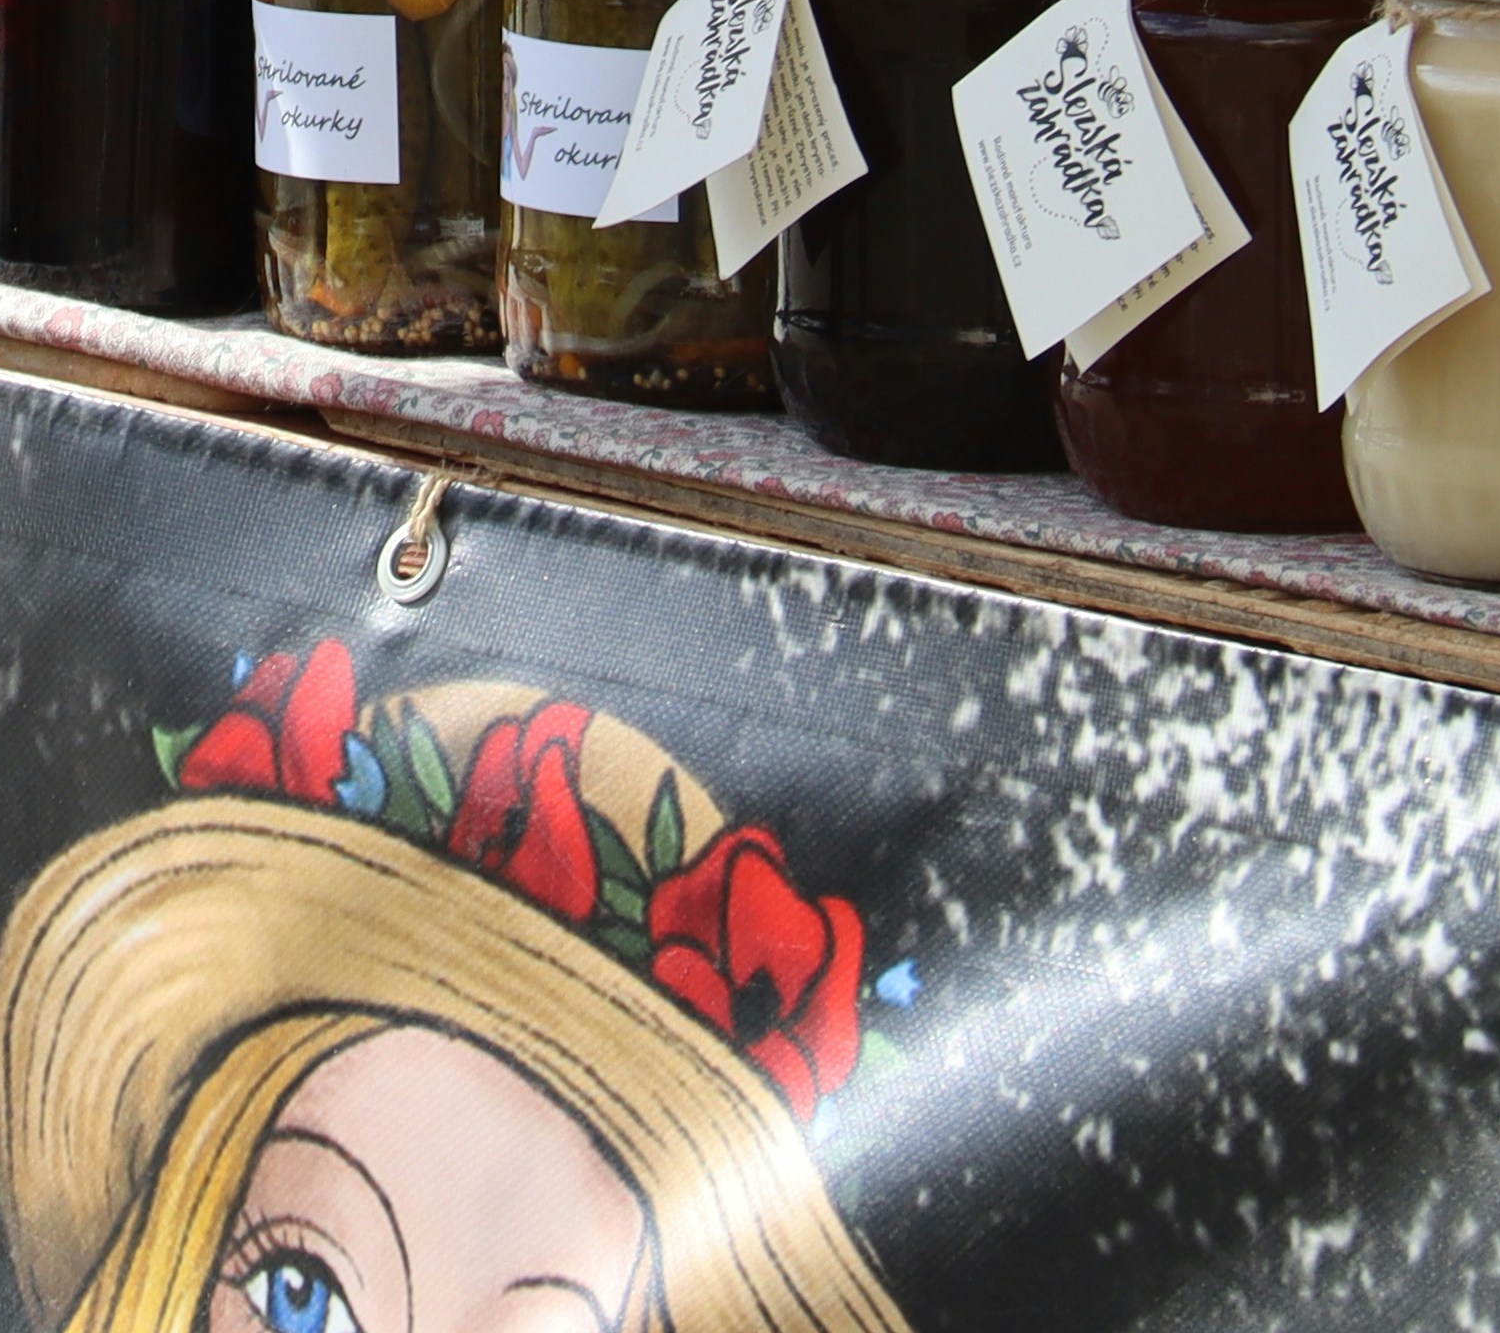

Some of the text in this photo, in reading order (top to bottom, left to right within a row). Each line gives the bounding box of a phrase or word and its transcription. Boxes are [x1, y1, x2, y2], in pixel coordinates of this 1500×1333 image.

[256, 55, 367, 92] Sterilované
[280, 107, 364, 140] okurky
[518, 89, 632, 127] Sterilovan
[553, 143, 624, 170] okur
